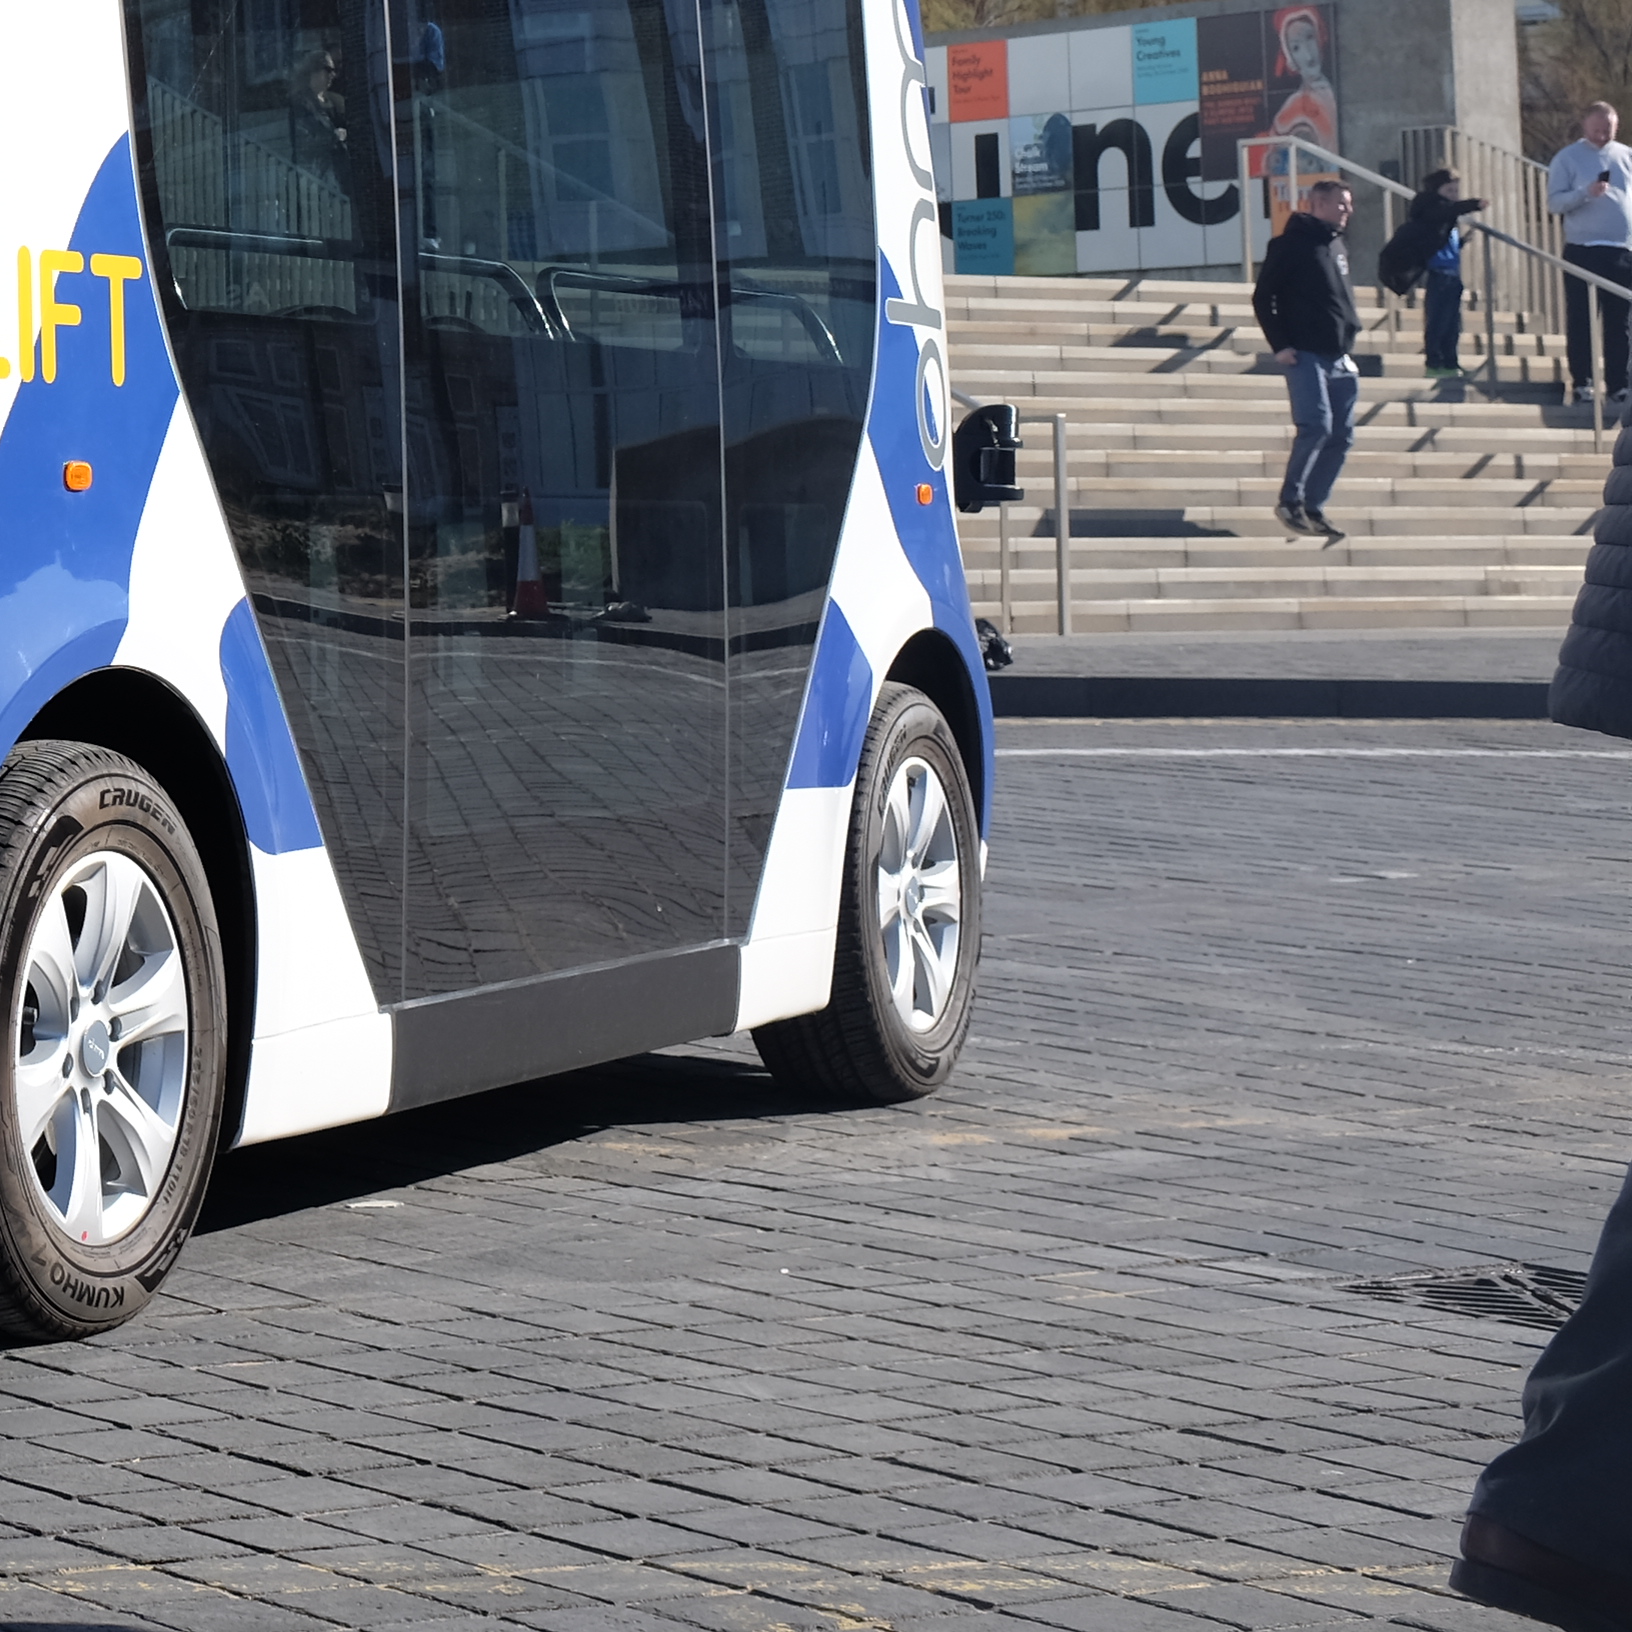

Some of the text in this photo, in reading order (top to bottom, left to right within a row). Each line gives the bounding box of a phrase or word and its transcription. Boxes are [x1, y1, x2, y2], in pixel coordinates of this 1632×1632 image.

[1136, 35, 1166, 48] Young
[952, 55, 982, 67] Family
[1137, 49, 1181, 62] Creatives
[952, 68, 994, 82] Highlight
[953, 84, 972, 94] Tour
[98, 787, 177, 835] CRUGEN
[49, 1261, 125, 1309] KUMHO
